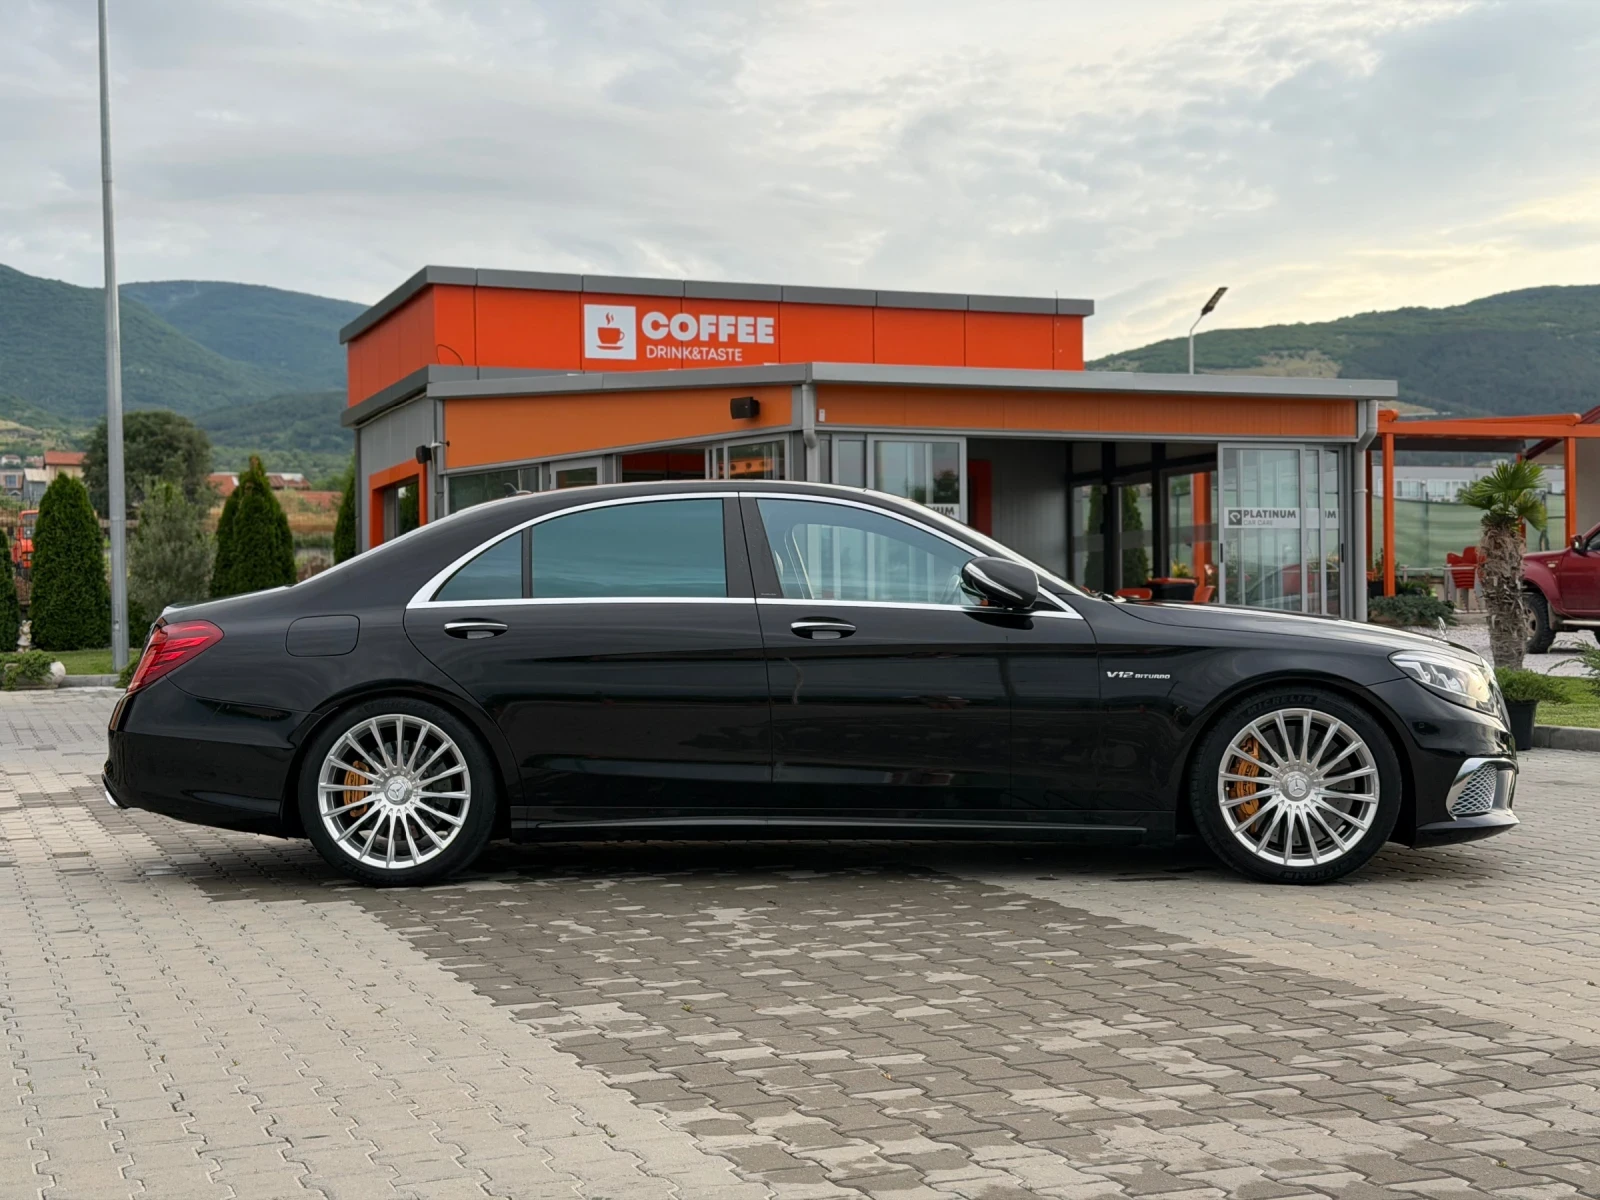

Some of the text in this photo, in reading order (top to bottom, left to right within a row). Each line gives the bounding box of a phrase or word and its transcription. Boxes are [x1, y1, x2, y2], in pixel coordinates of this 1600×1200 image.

[641, 311, 775, 344] COFFEE
[646, 345, 743, 361] DRINK&TASTE
[1243, 509, 1297, 519] PLATINUM
[1106, 671, 1134, 679] V12
